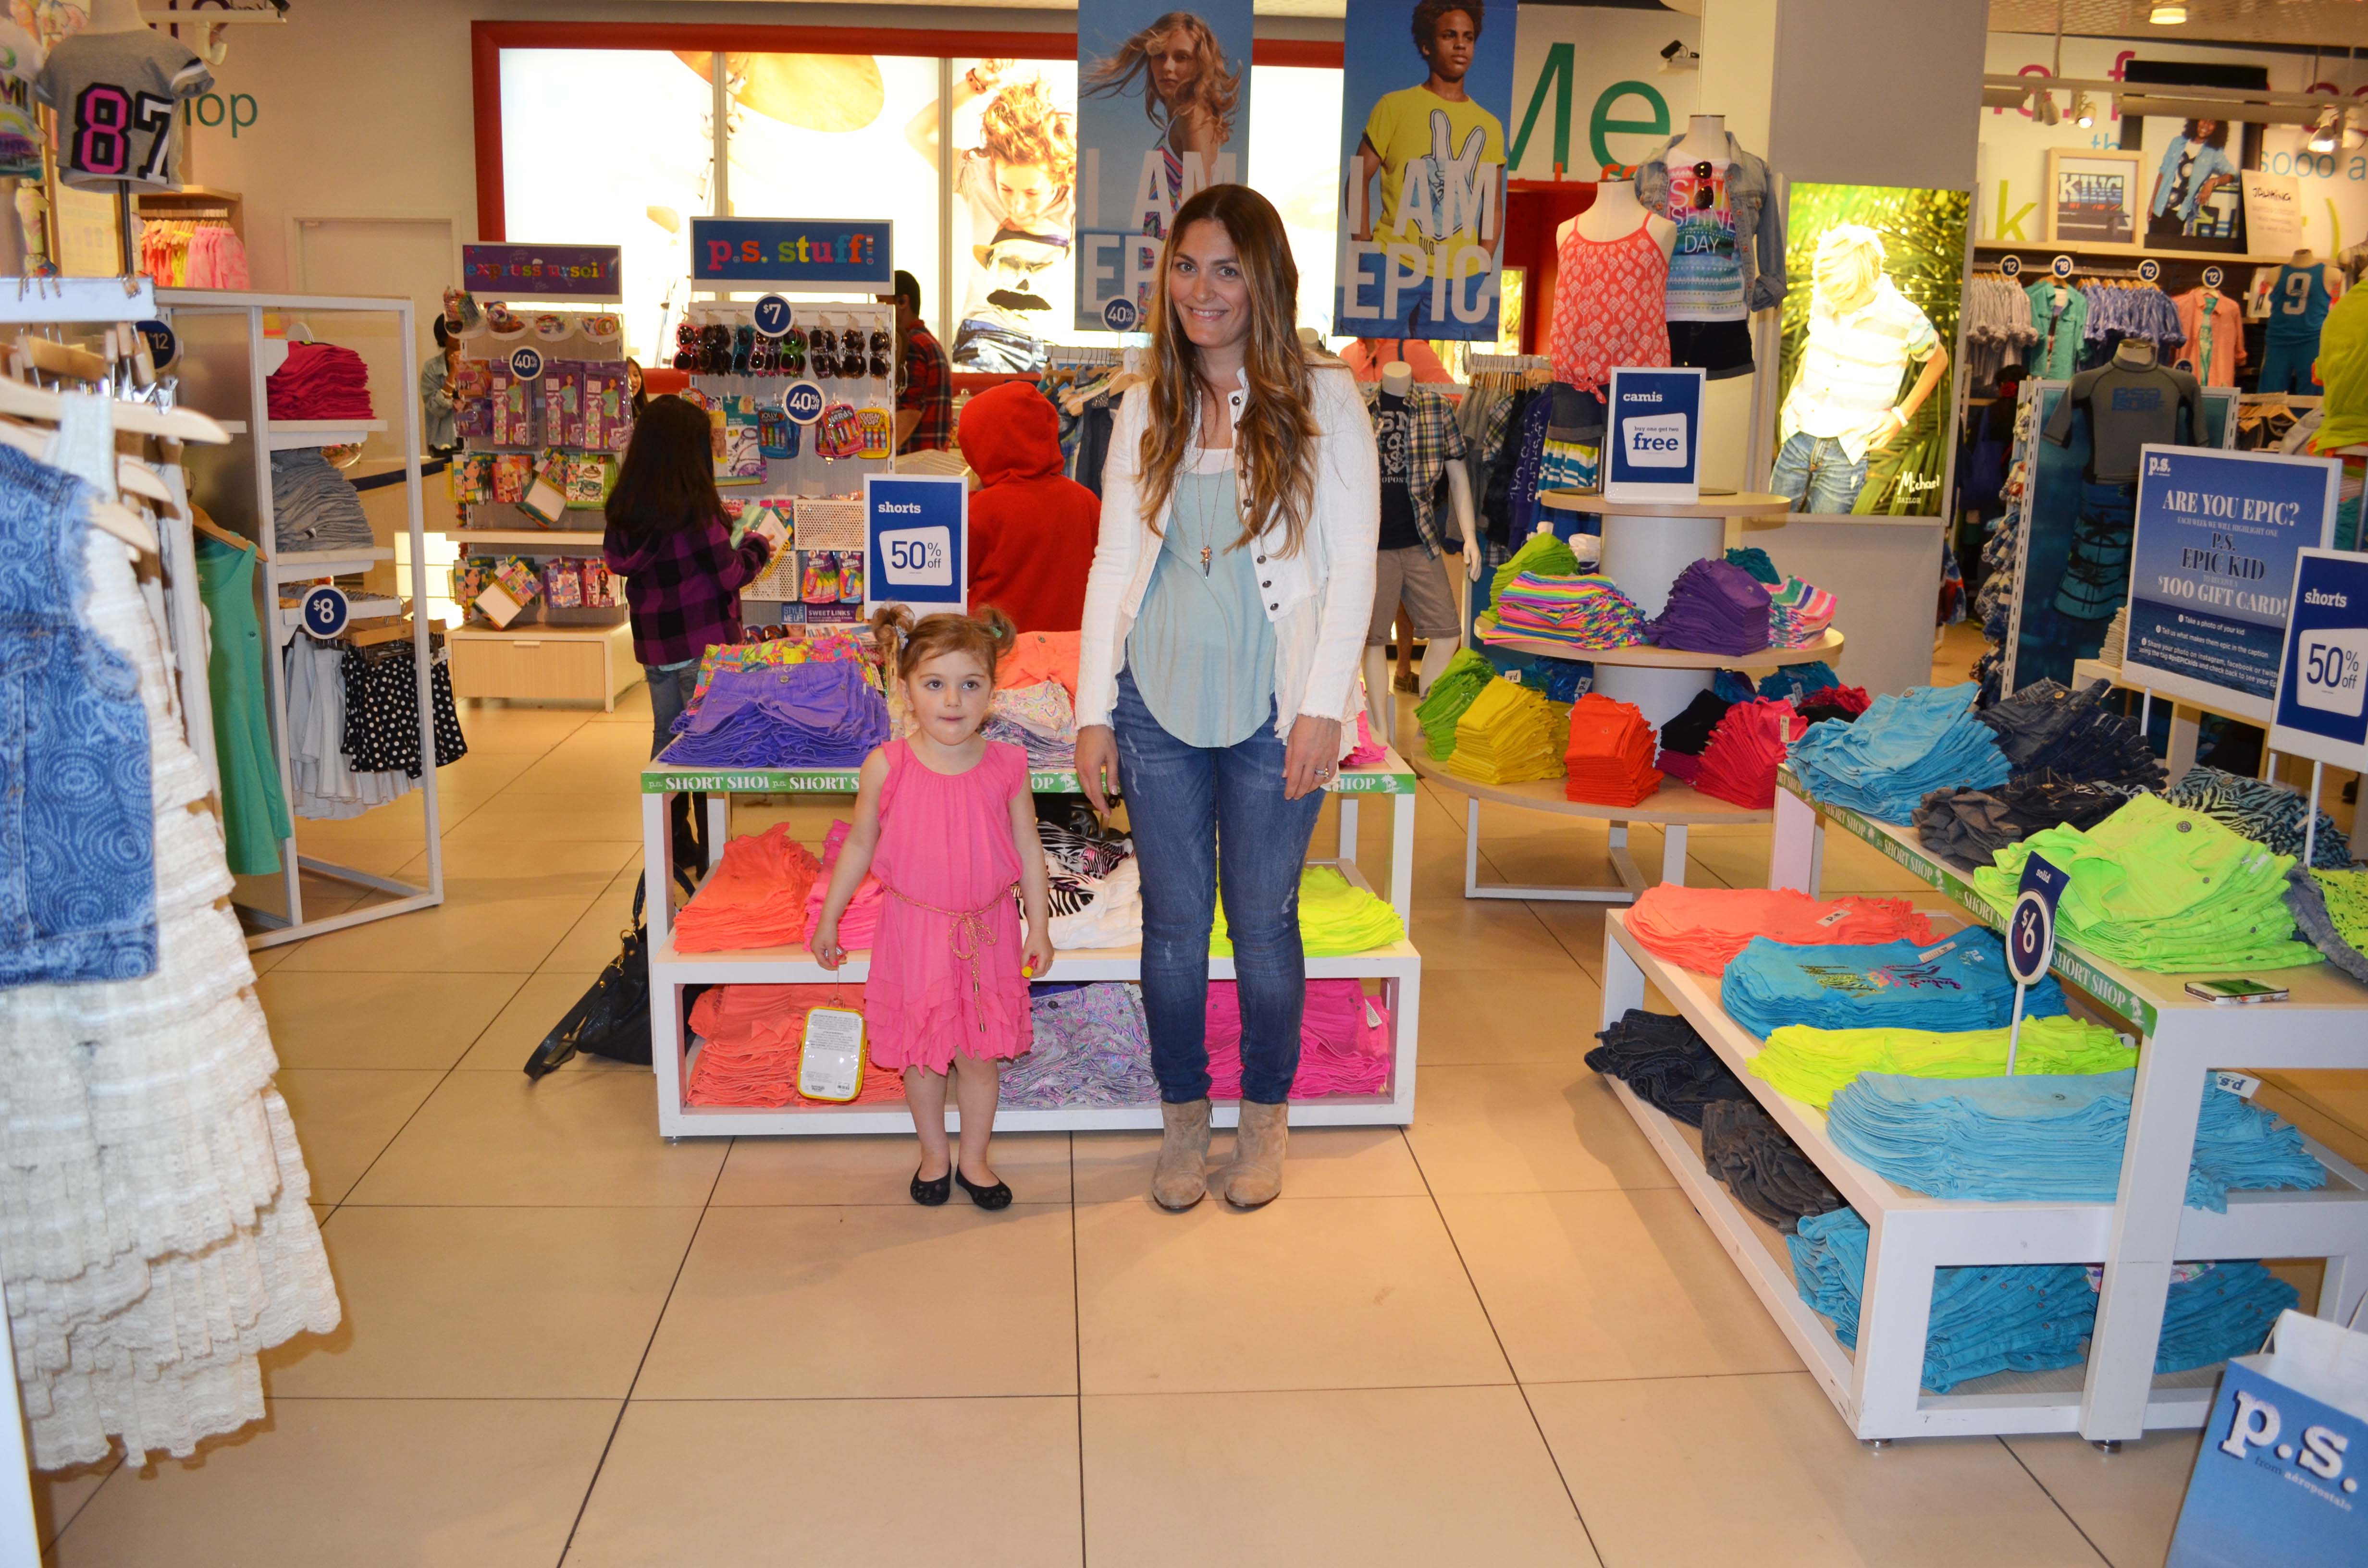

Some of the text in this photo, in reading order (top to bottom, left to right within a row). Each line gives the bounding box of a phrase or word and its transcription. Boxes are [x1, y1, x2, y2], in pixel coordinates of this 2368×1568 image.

[71, 82, 174, 184] 87
[1085, 149, 1099, 228] I
[1348, 156, 1497, 240] I AM
[707, 234, 874, 270] p.s. stuff!
[1685, 234, 1719, 254] DAY
[465, 264, 543, 281] express
[1083, 234, 1165, 313] EP
[1343, 241, 1493, 323] EPIC
[2283, 272, 2312, 315] 9
[763, 304, 781, 324] $7
[1623, 391, 1663, 402] camis
[1633, 432, 1678, 451] free
[878, 502, 921, 514] shorts
[2162, 490, 2300, 526] ARE YOU EPIC?
[2212, 531, 2235, 551] P.S.
[927, 558, 941, 568] off
[2181, 547, 2265, 580] EPIC KID
[2158, 575, 2287, 618] $100 GIFT CARD!
[2304, 588, 2347, 608] shorts
[313, 598, 334, 623] $8
[784, 606, 803, 614] STYLE
[2185, 616, 2196, 624] Take
[2200, 620, 2216, 629] photo
[2223, 626, 2235, 634] your
[2236, 626, 2245, 635] kid
[2176, 630, 2189, 639] what
[2189, 634, 2205, 644] makes
[2206, 637, 2219, 647] them
[2220, 641, 2231, 650] epic
[2232, 643, 2237, 651] in
[2238, 645, 2247, 654] the
[2247, 649, 2269, 659] caption
[2147, 640, 2161, 649] Share
[2161, 644, 2173, 652] your
[2173, 647, 2189, 656] photo
[2227, 659, 2253, 672] facebook
[2209, 664, 2224, 674] check
[2256, 677, 2269, 686] your
[2342, 674, 2357, 689] off
[648, 780, 663, 789] p.s.
[666, 776, 724, 790] SHORT
[772, 779, 787, 788] p.s.
[789, 776, 848, 790] SHORT
[1031, 777, 1054, 789] OP
[1339, 777, 1376, 791] HOP
[1847, 817, 1866, 836] SHOP
[1883, 839, 1933, 881] SHORT SHOP
[2035, 869, 2051, 884] solid
[1963, 891, 1994, 923] SHORT
[2021, 908, 2036, 954] $6
[2051, 949, 2126, 1009] SHORT SHOP
[2218, 1389, 2357, 1493] p.s.
[2255, 1456, 2282, 1475] from
